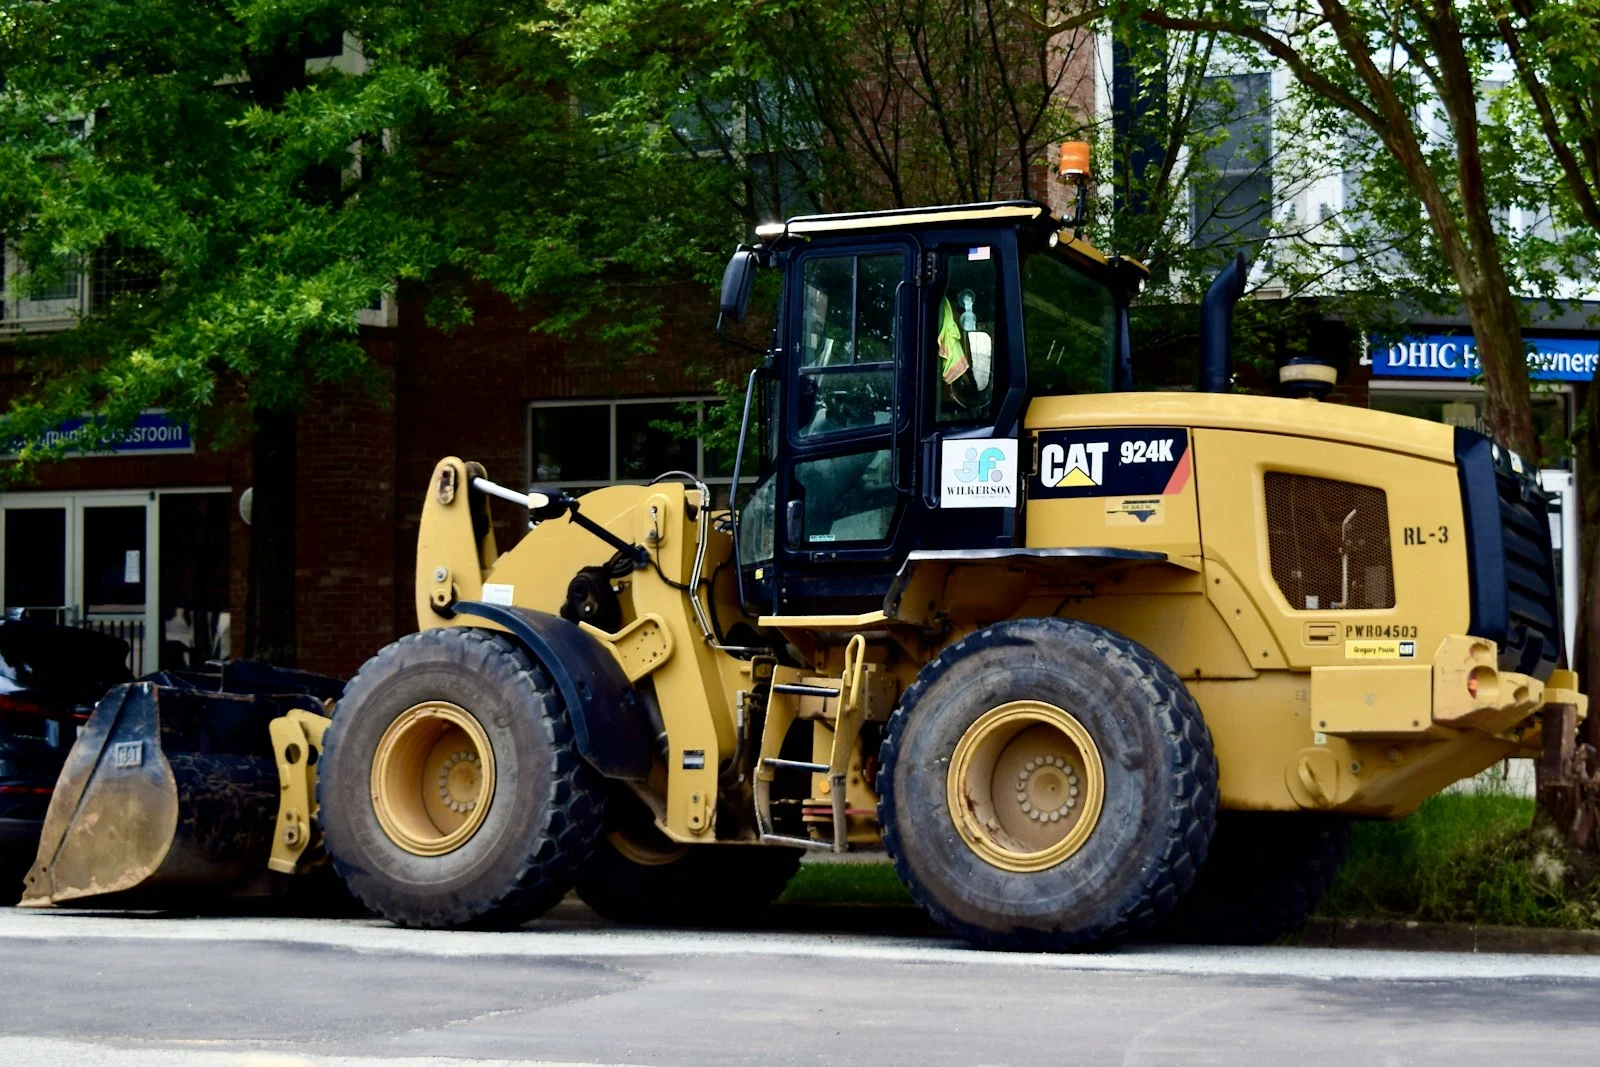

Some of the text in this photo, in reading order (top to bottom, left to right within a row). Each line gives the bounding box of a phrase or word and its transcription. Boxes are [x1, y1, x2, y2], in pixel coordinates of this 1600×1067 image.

[1387, 342, 1456, 368] DHIC
[1120, 439, 1174, 464] 924K
[1041, 442, 1109, 488] CAT
[947, 485, 1012, 496] WILKERSON
[1403, 526, 1449, 545] RL-3
[1346, 625, 1418, 638] PWR04503
[1353, 646, 1377, 654] Gregory
